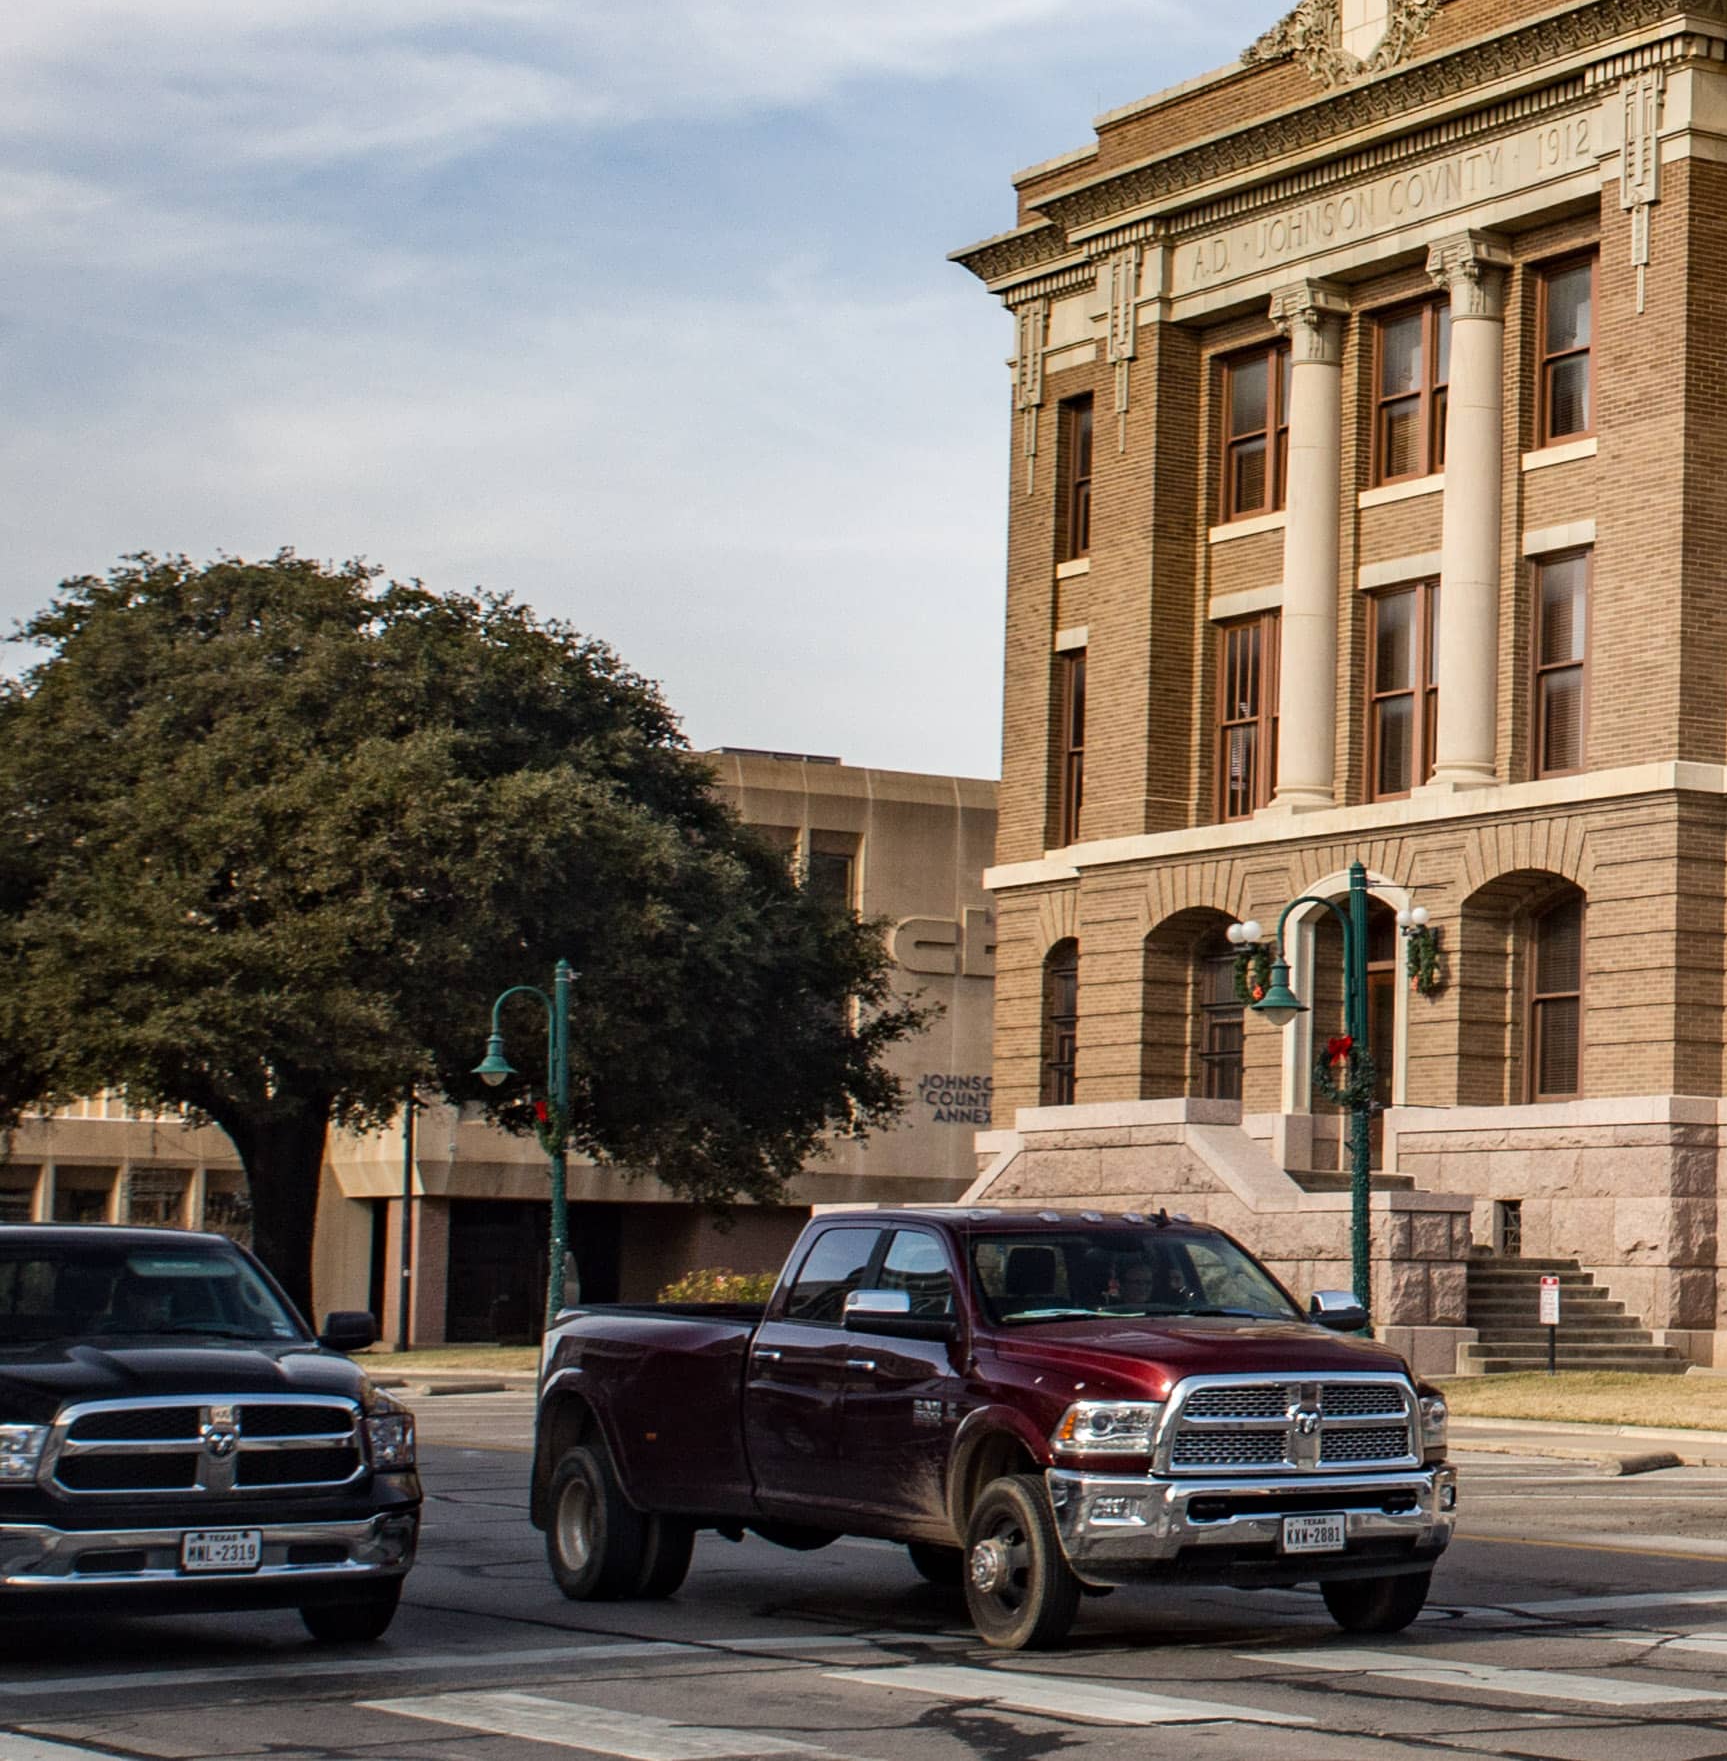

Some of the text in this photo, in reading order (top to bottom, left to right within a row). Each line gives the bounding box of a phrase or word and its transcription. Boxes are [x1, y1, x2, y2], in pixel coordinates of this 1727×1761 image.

[1192, 118, 1591, 282] A.D. JOHNSON COVNTY 1912
[918, 1073, 992, 1091] JOHNSO
[926, 1090, 992, 1107] COUNT
[1303, 1518, 1327, 1526] TEXAS
[208, 1534, 239, 1542] TEXAS
